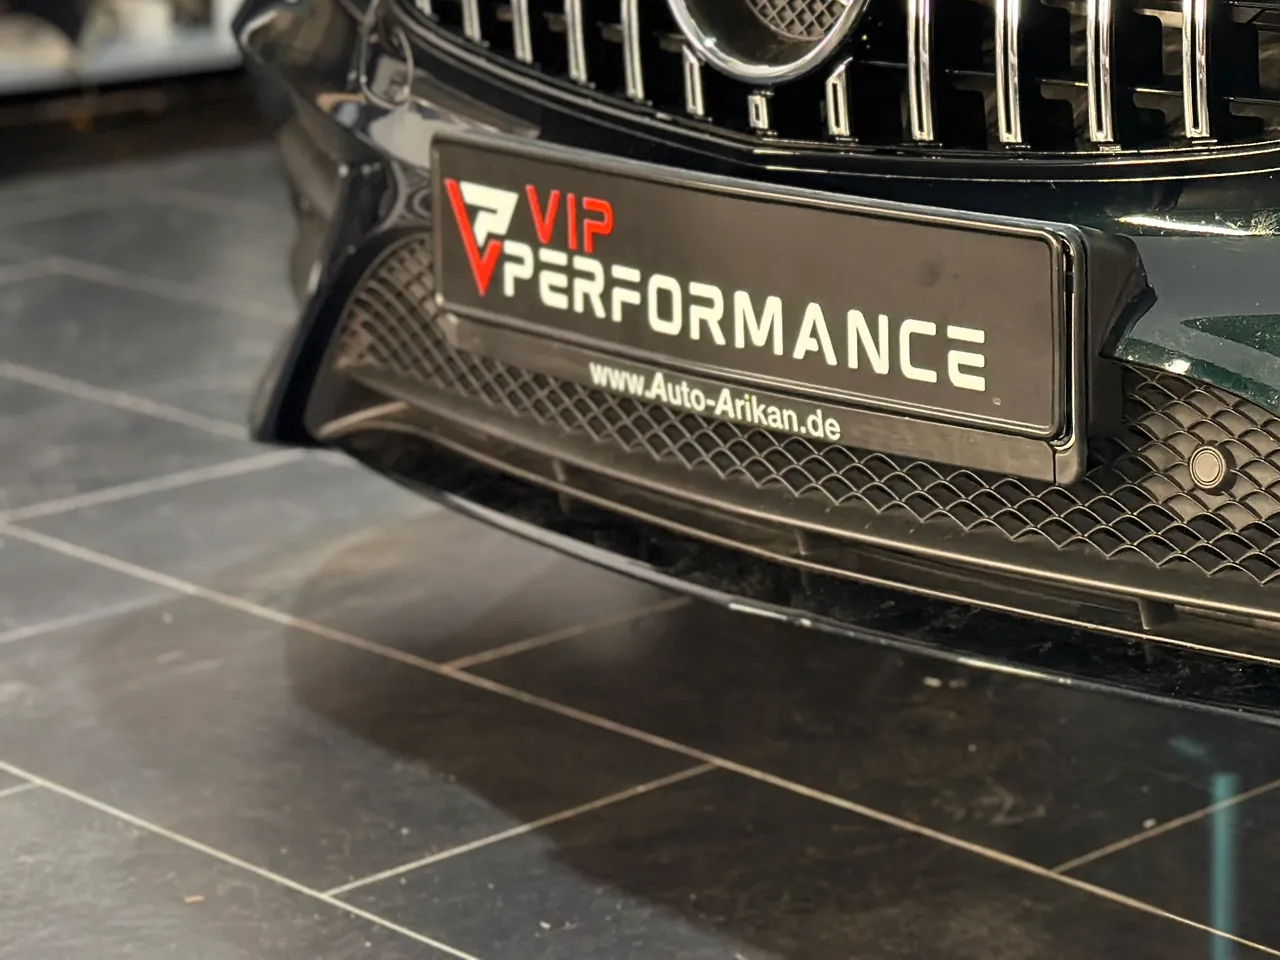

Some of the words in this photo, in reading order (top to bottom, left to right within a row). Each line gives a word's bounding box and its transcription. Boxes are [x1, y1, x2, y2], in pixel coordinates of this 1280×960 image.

[525, 184, 614, 254] VIP
[503, 240, 986, 392] PERFORMANCE
[589, 361, 841, 440] www.Auto-Arikan.de
